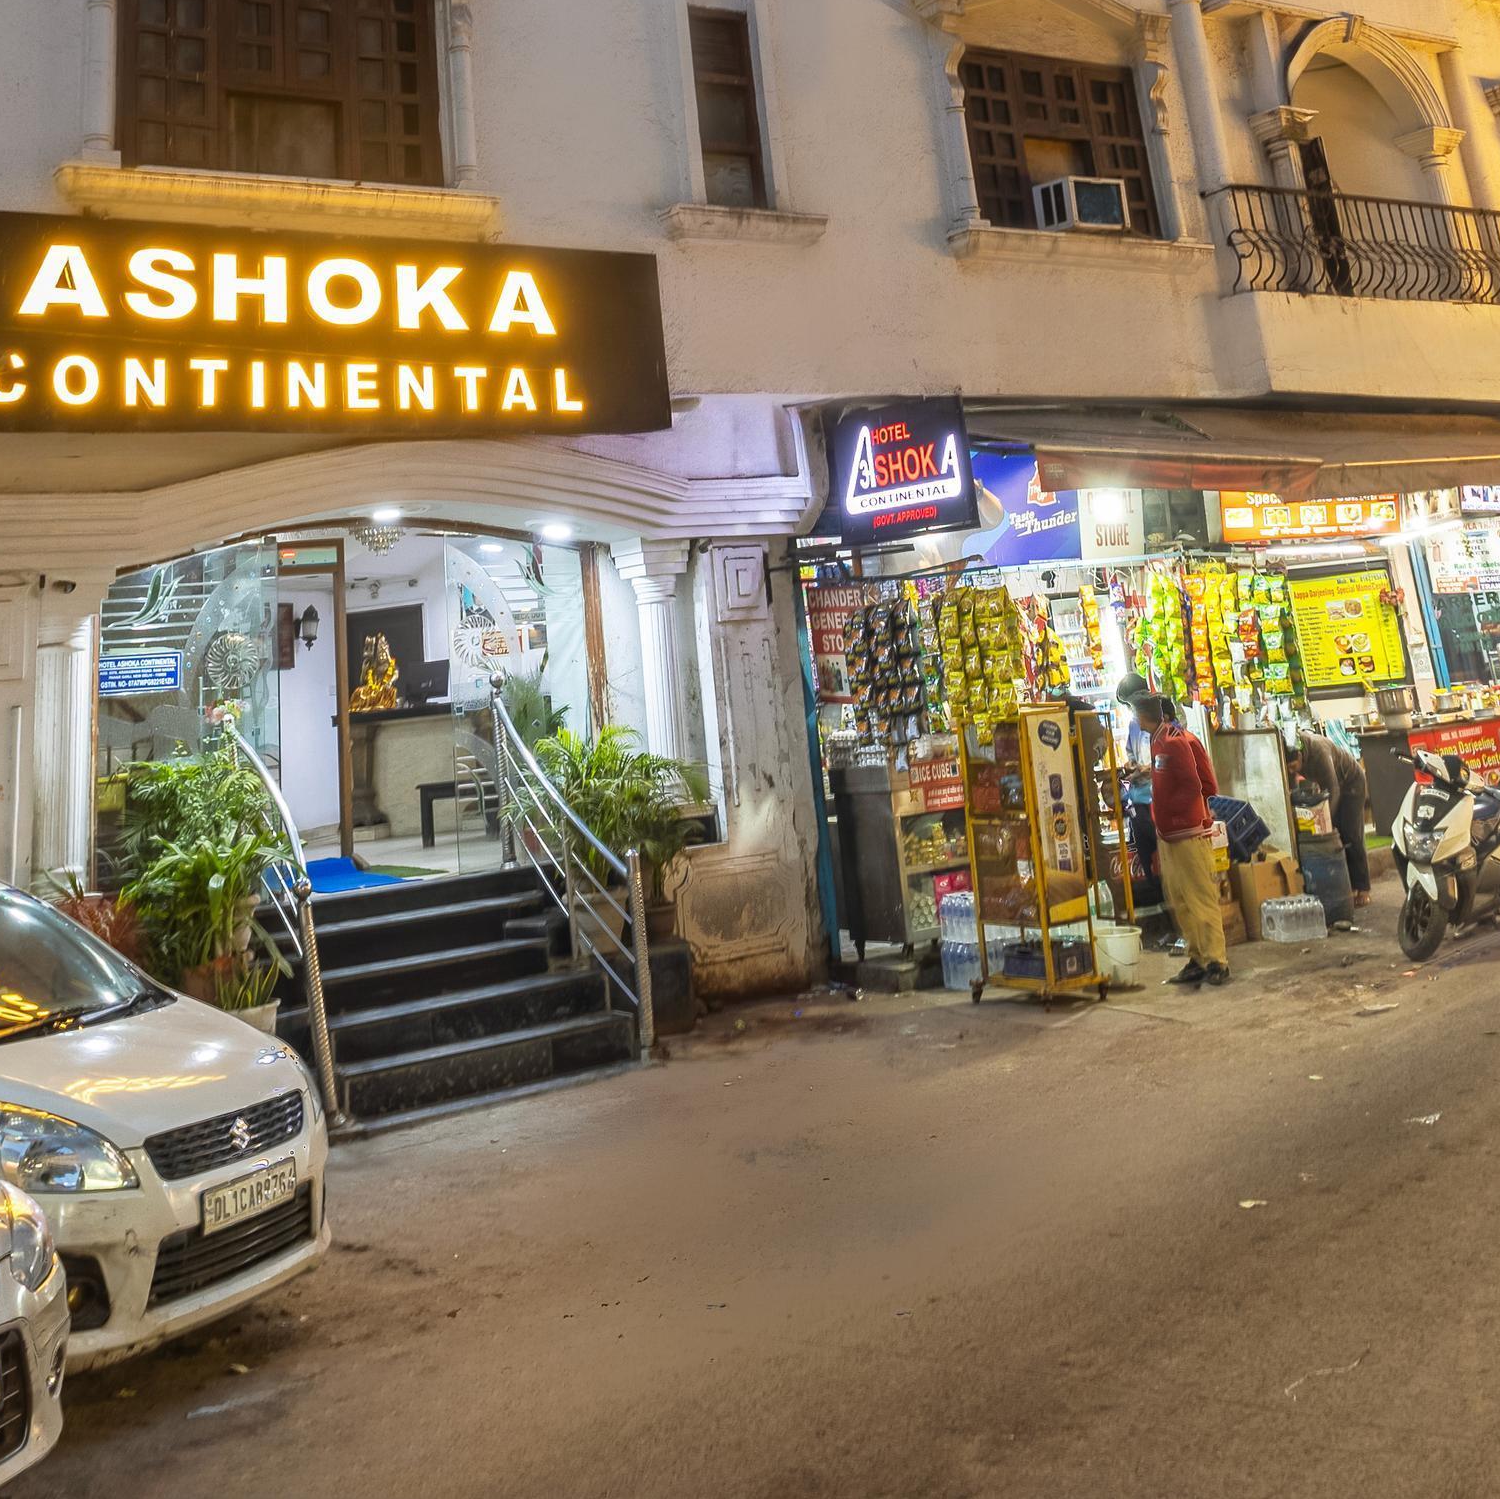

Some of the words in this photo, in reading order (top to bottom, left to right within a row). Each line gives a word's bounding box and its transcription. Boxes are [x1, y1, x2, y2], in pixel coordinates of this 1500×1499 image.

[18, 245, 557, 335] ASHOKA
[871, 422, 911, 446] HOTEL
[860, 485, 948, 508] CONTINENTAL
[897, 506, 937, 523] APPROVED)
[1010, 510, 1035, 526] Taste
[1017, 510, 1077, 537] Thunder
[1096, 523, 1129, 547] STORE
[808, 589, 862, 608] CHANDER
[822, 634, 844, 652] STO
[99, 660, 116, 668] HOTEL
[140, 657, 176, 666] CONTINENTAL
[1458, 738, 1497, 756] Darjeeling
[919, 765, 931, 783] ICE
[932, 762, 950, 780] CUBE
